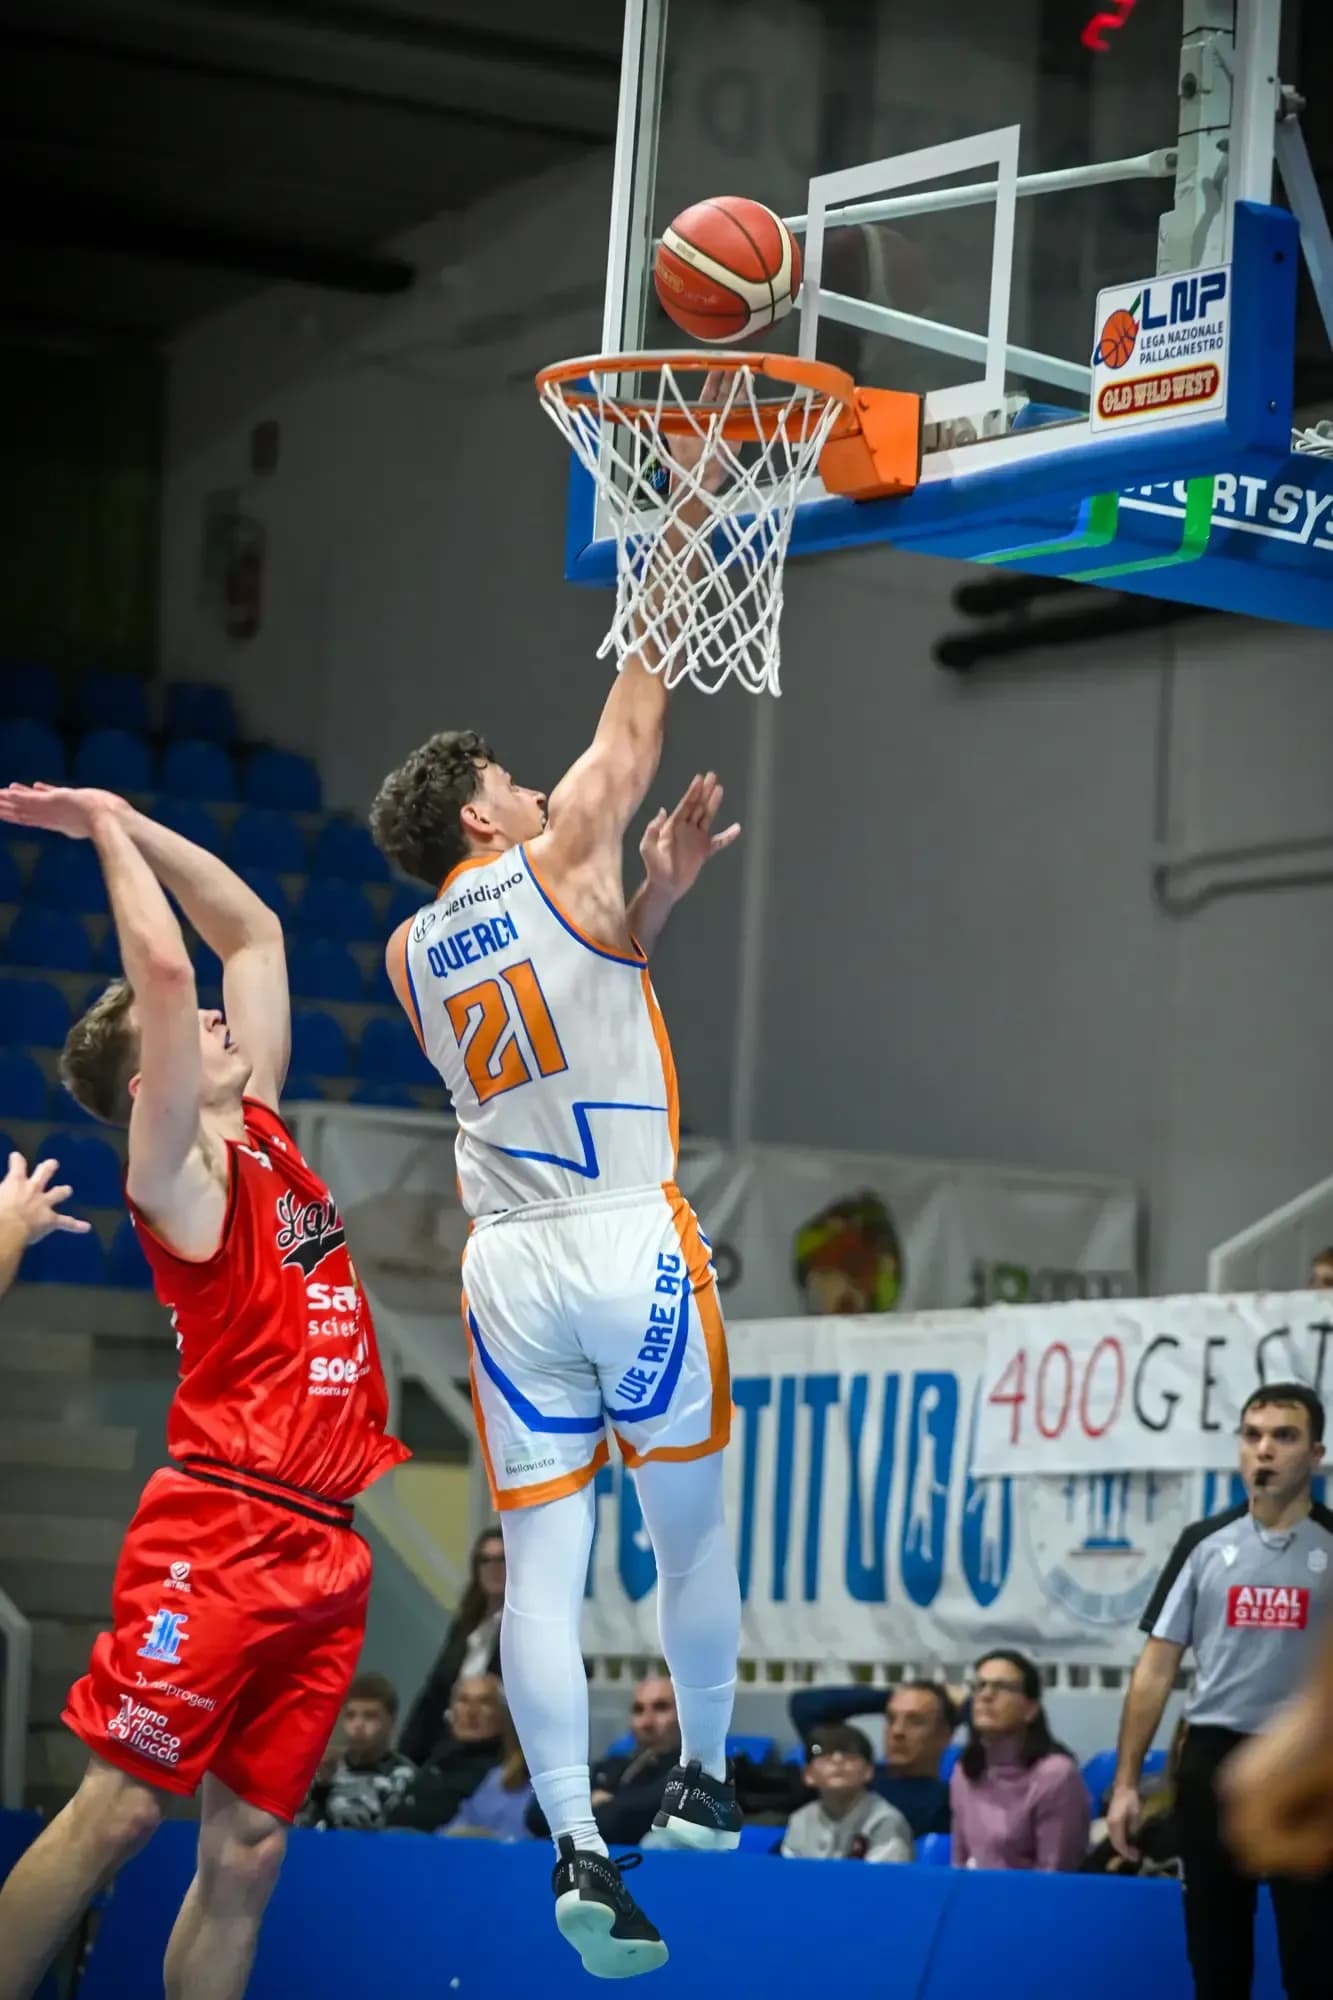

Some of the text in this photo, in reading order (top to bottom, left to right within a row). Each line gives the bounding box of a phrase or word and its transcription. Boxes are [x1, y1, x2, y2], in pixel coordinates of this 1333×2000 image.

[1142, 272, 1226, 330] LNP
[1139, 336, 1224, 365] PALLACANESTRO
[1140, 321, 1224, 350] LEGA NAZIONALE
[1102, 369, 1215, 414] OLD WILD WEST
[443, 958, 569, 1106] 21
[615, 1366, 658, 1405] WE
[638, 1303, 676, 1364] ARE
[1234, 1605, 1301, 1621] GROUP
[1236, 1586, 1301, 1607] ATTAL
